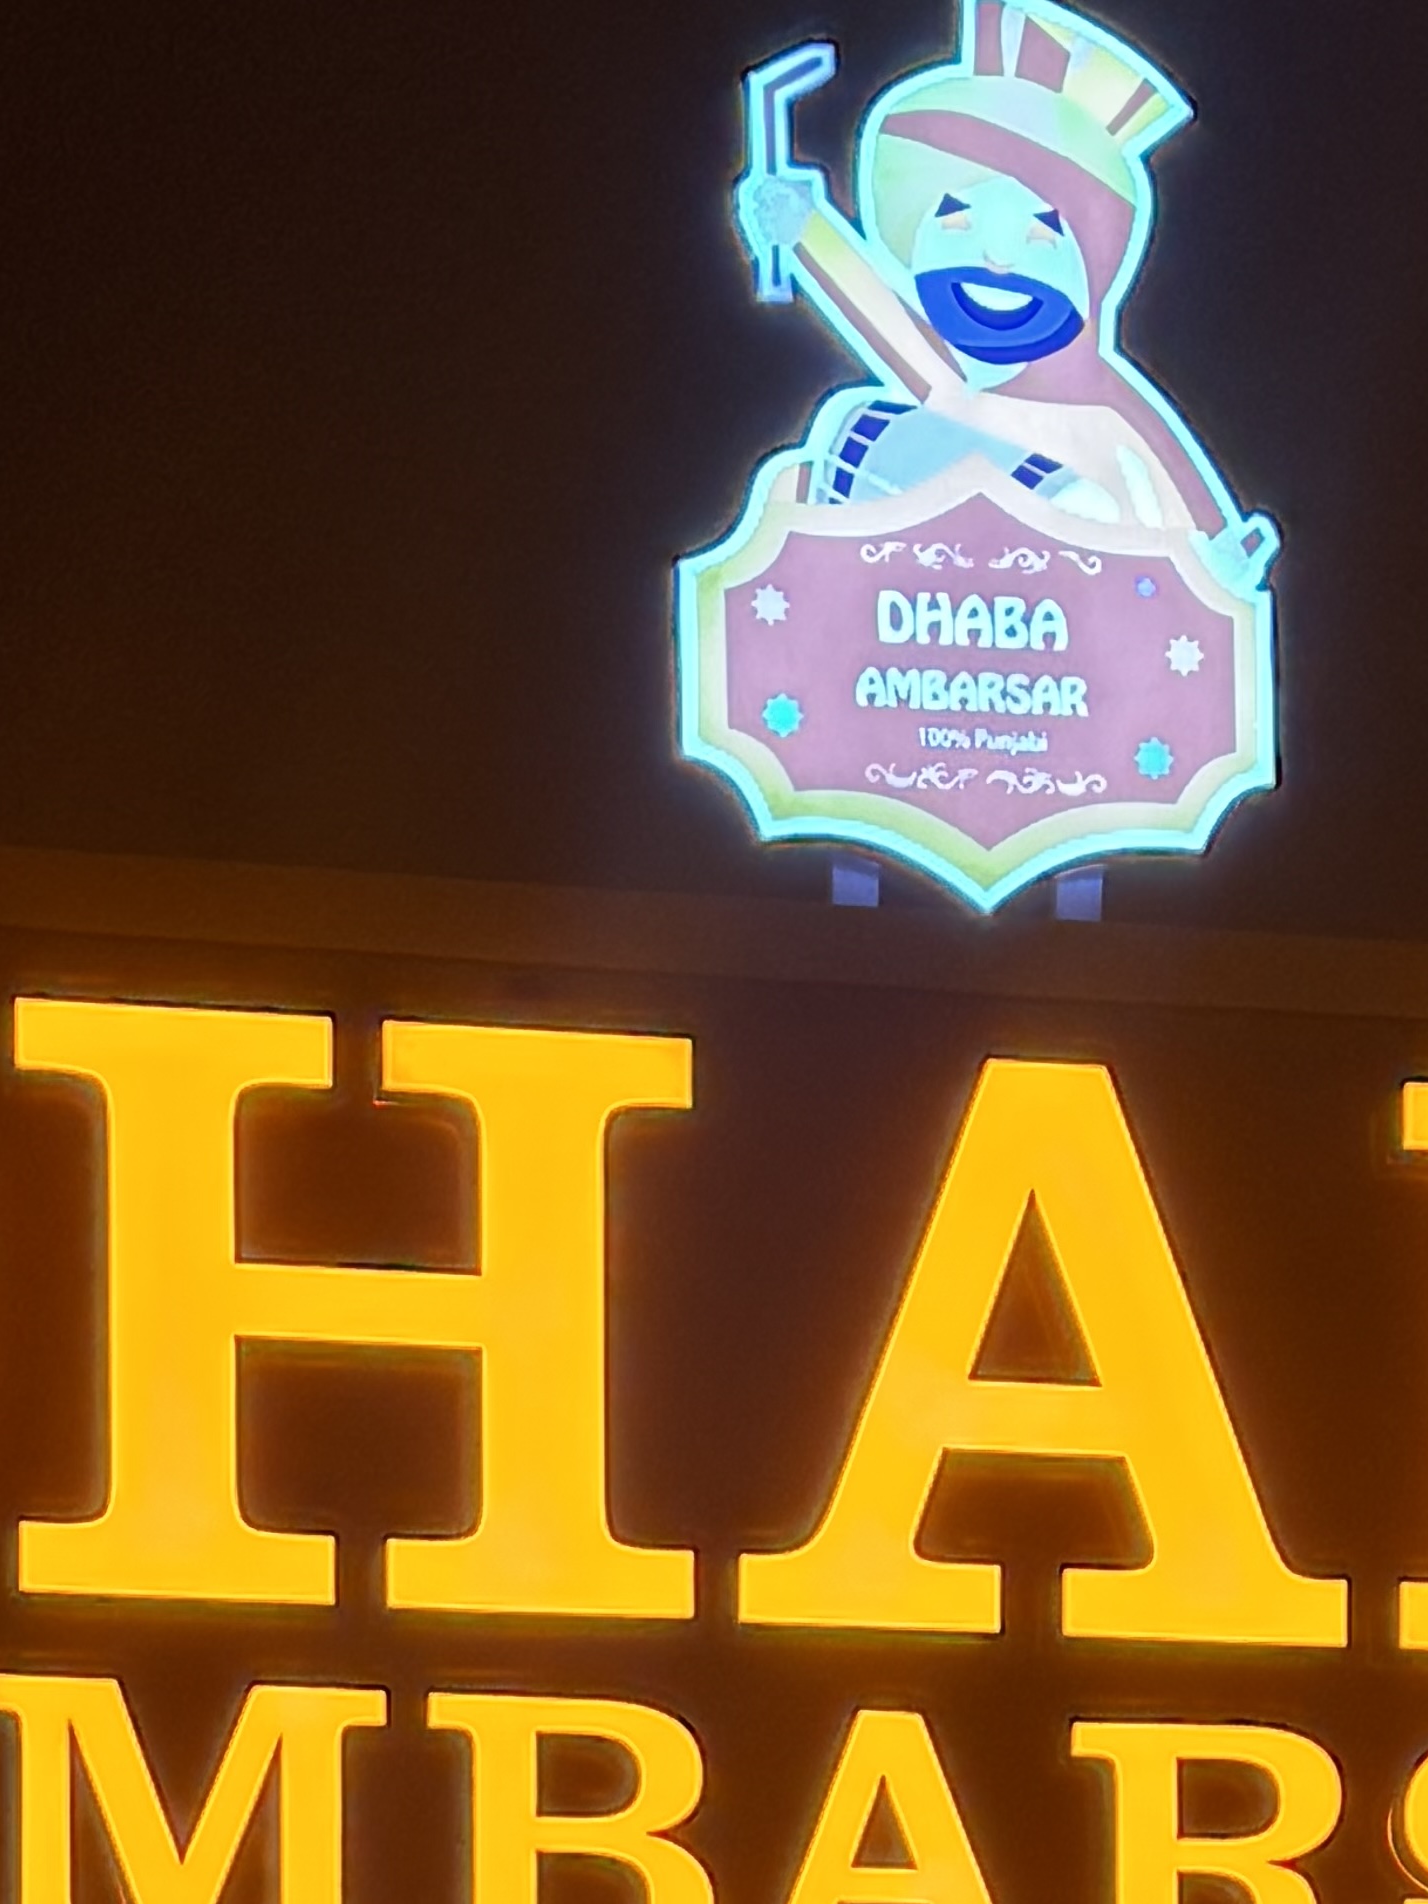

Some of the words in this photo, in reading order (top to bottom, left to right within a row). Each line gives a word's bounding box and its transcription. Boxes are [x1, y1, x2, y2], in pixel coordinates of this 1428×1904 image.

[877, 588, 1069, 652] DHABA
[855, 665, 1090, 717] AMBARSAR
[918, 726, 971, 749] 100%
